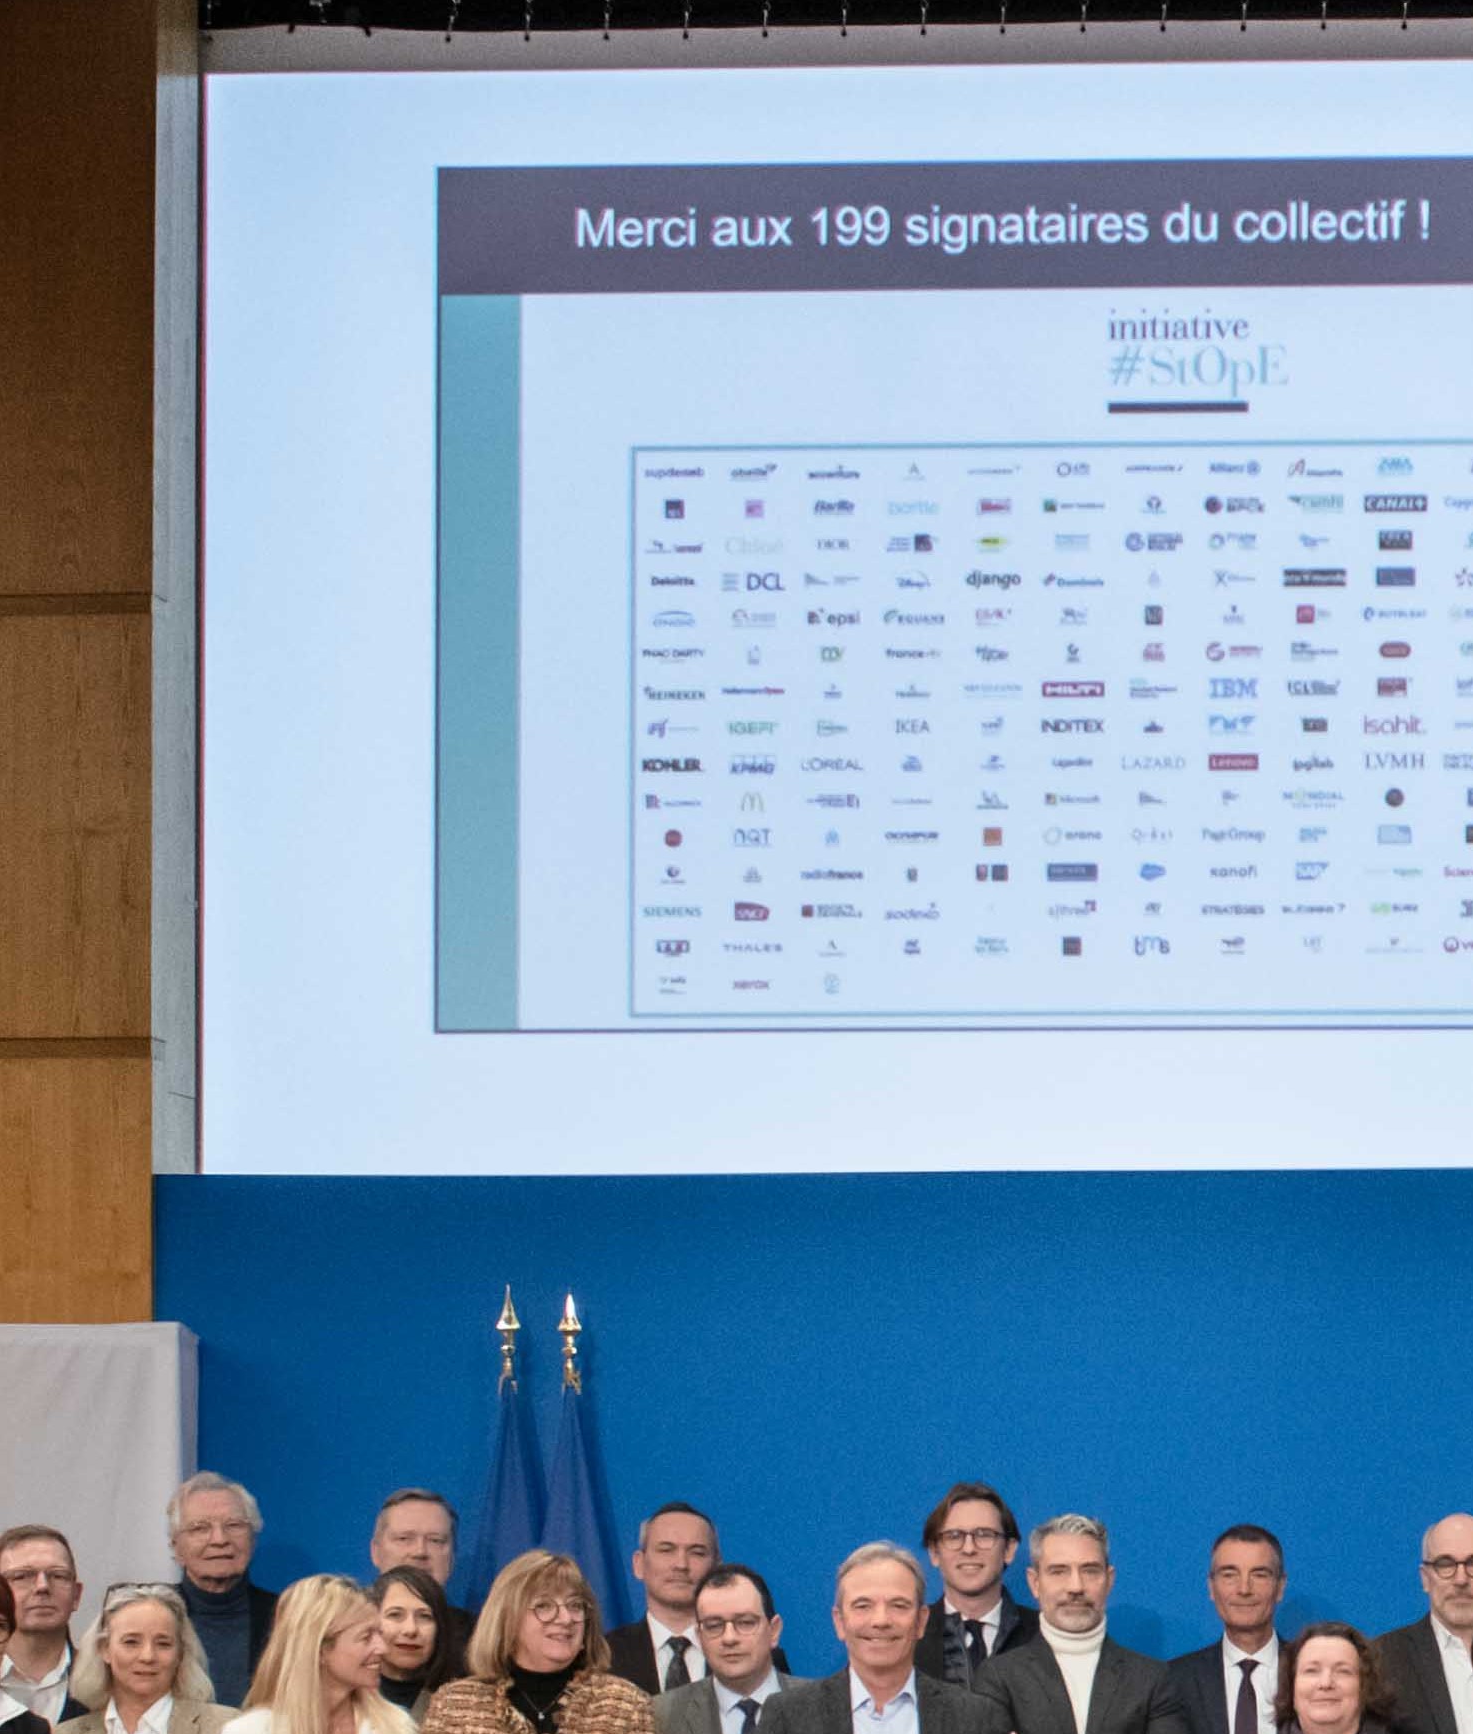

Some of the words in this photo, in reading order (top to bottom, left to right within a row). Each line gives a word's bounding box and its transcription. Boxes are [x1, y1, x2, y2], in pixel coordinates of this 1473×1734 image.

[576, 207, 696, 247] Merci
[712, 216, 793, 247] aux
[811, 205, 892, 246] 199
[904, 204, 1150, 255] signataires
[1163, 202, 1219, 243] du
[1234, 199, 1407, 243] collectif
[1418, 199, 1430, 241] !
[1108, 309, 1250, 341] initiative
[1108, 343, 1289, 397] #StOpE
[1366, 497, 1425, 510] CANAL+
[746, 573, 786, 591] DCL
[966, 570, 1021, 589] django
[827, 610, 861, 627] epsi
[649, 690, 705, 700] HEINEKEN
[1045, 684, 1102, 695] HILTI
[1209, 678, 1258, 698] IBM
[895, 719, 931, 734] IKEA
[1041, 719, 1104, 733] INDITEX
[642, 759, 702, 772] KOHLER
[730, 762, 775, 774] KPMG
[1122, 756, 1186, 771] LAZARD
[1212, 756, 1256, 768] Lenovo
[1365, 753, 1425, 769] LVMH
[800, 869, 863, 880] radiofrance
[1210, 865, 1258, 878] sanofi
[642, 906, 702, 918] SIEMENS
[723, 943, 783, 952] THALES
